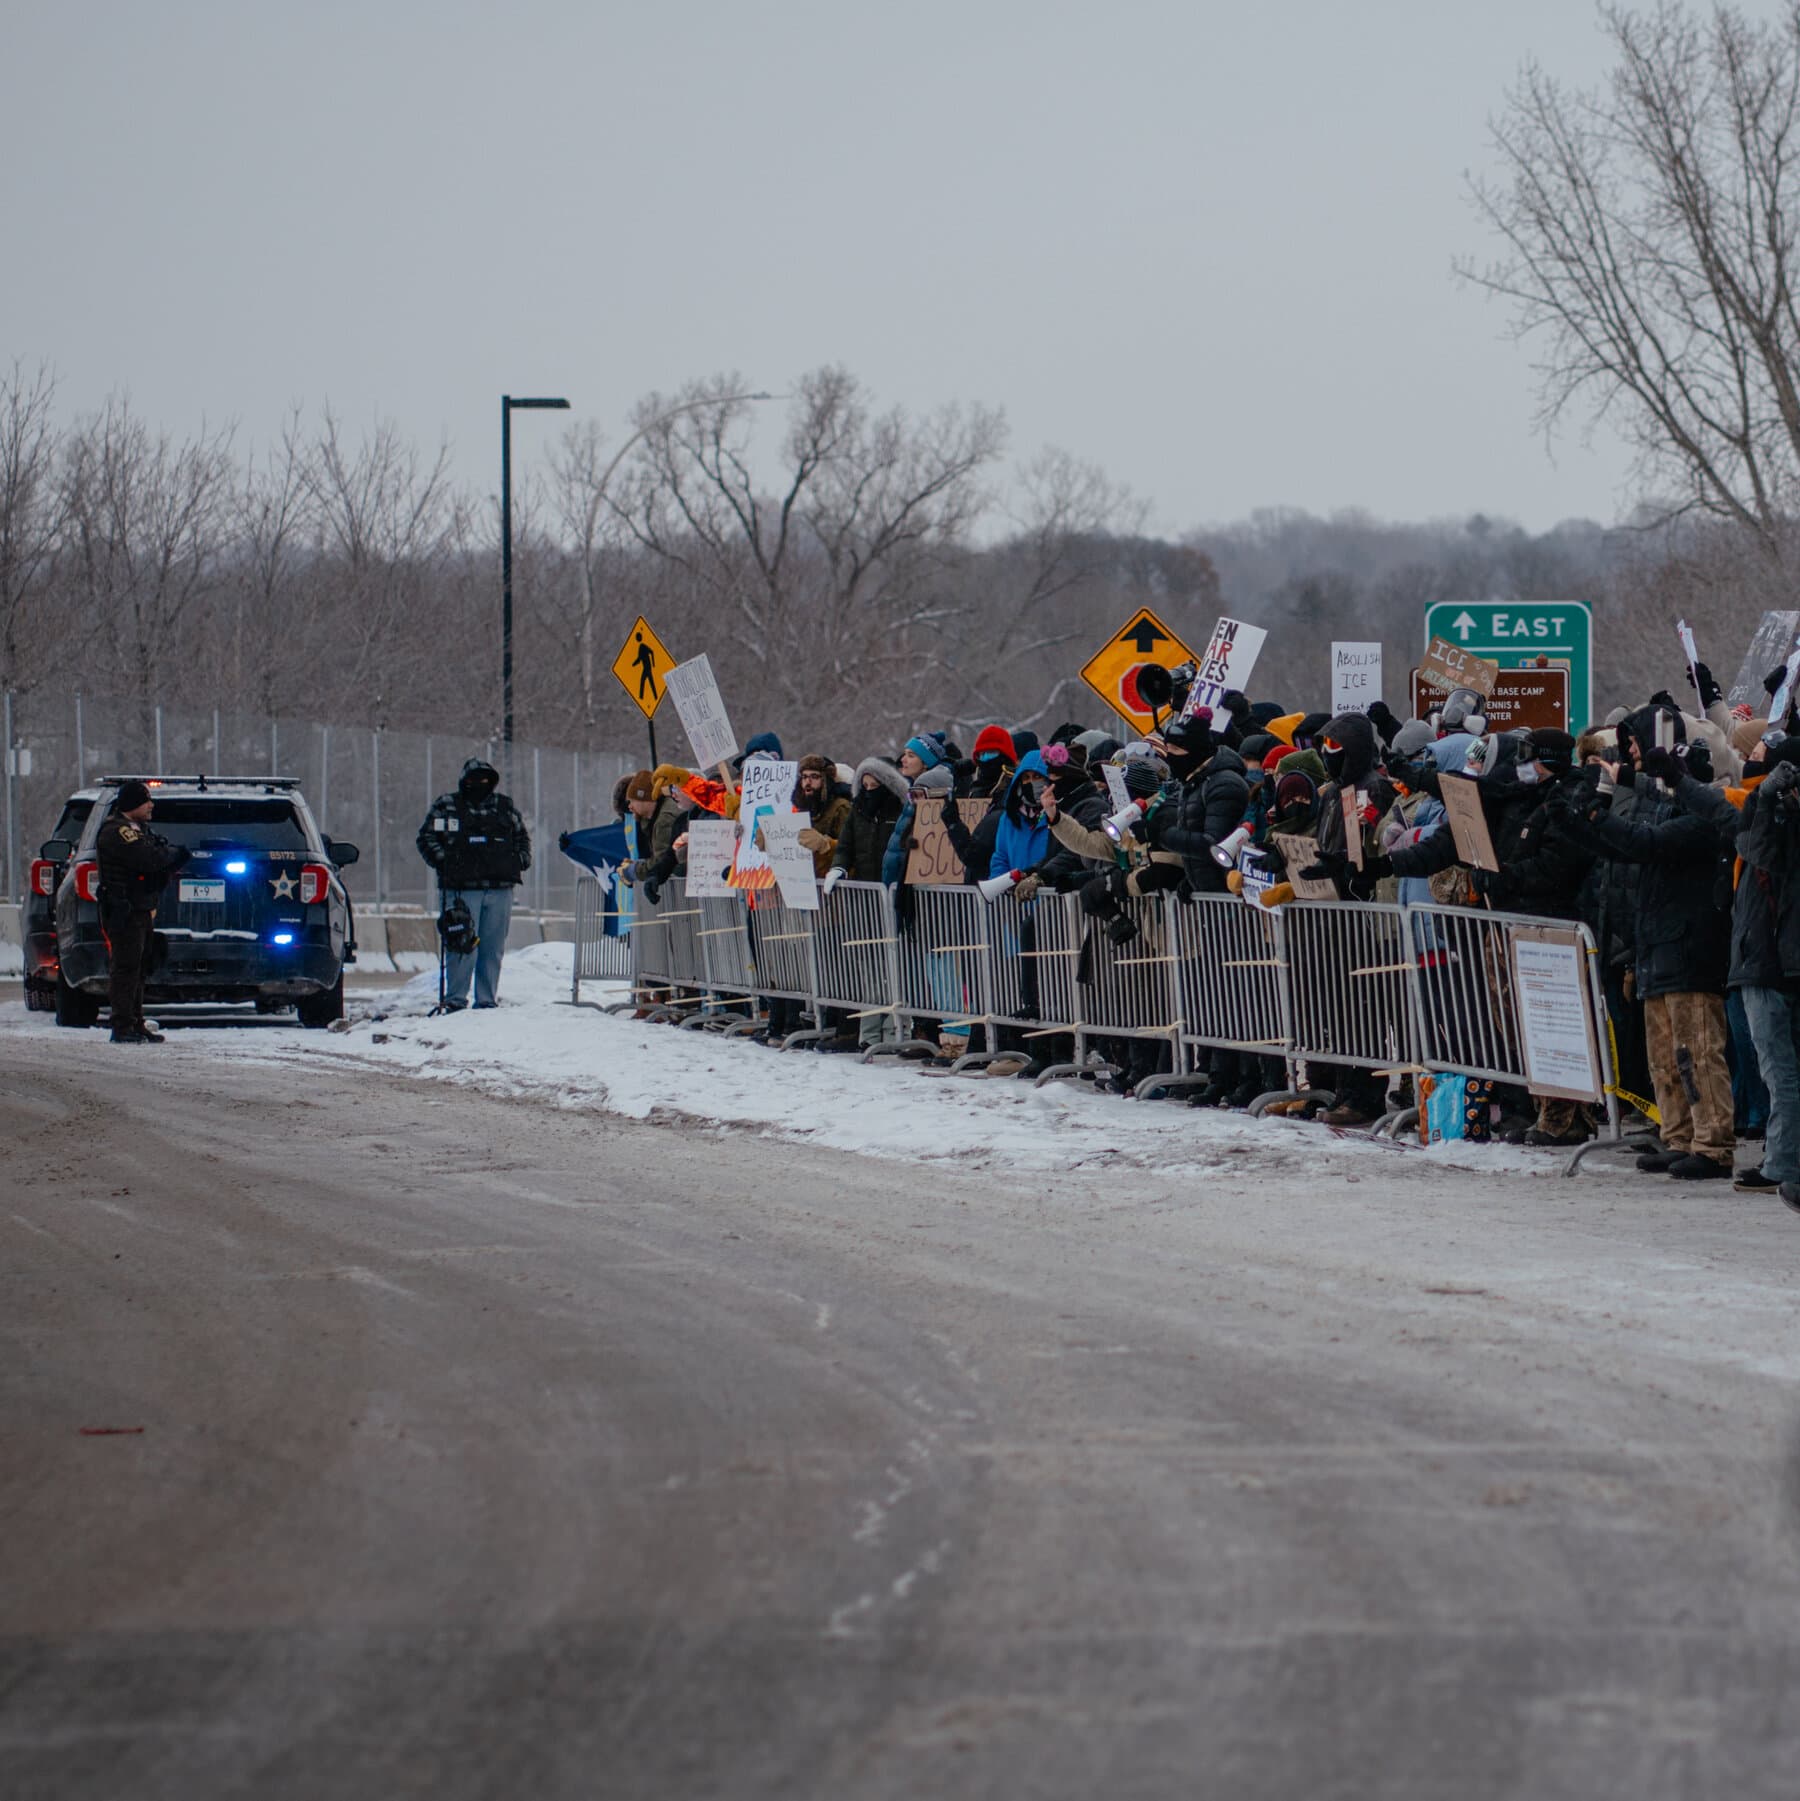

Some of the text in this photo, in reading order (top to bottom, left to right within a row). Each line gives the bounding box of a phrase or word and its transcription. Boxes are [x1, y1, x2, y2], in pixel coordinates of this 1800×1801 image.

[1492, 613, 1566, 637] EAST
[1337, 649, 1381, 668] ABOLISH
[1430, 640, 1468, 671] ICE
[1341, 673, 1368, 689] ICE
[1497, 687, 1520, 696] BASE
[1521, 687, 1545, 696] CAMP
[1486, 701, 1512, 709] ENNIS
[1513, 701, 1521, 709] &
[1485, 712, 1512, 721] ENTER
[744, 764, 791, 786] ABOLISH
[746, 783, 771, 805] ICE
[919, 831, 966, 877] SCU
[193, 886, 210, 897] K-9
